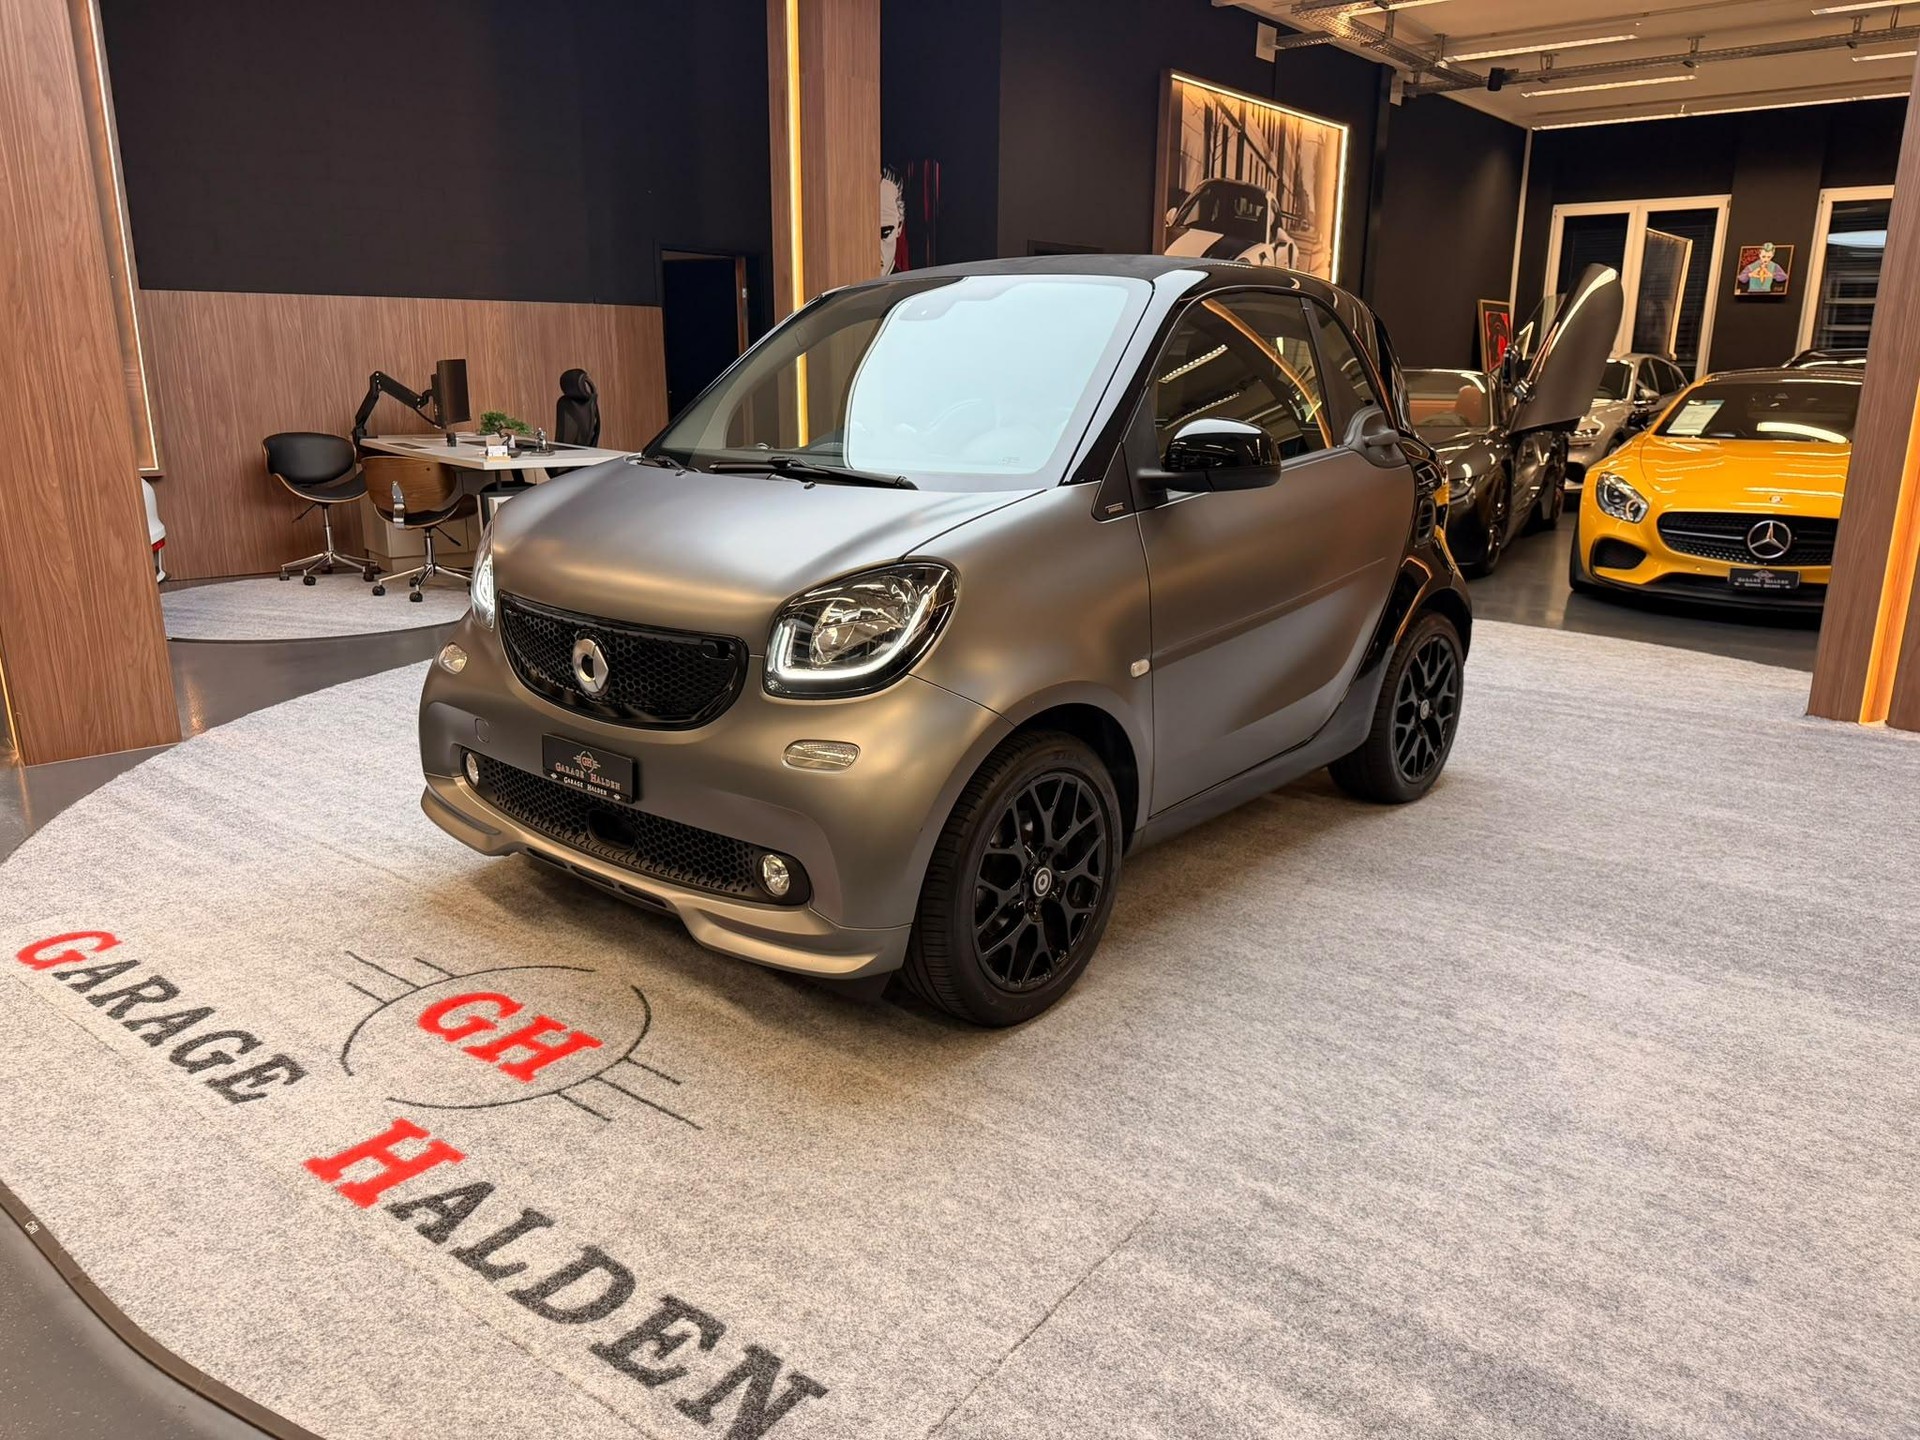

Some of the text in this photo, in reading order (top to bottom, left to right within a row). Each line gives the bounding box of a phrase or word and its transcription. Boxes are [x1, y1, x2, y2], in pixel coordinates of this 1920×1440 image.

[555, 762, 621, 791] GARAGE HALDEN
[563, 776, 608, 796] GARAGE HALDEN
[416, 991, 603, 1083] GH
[16, 930, 828, 1440] GARAGE HALDEN
